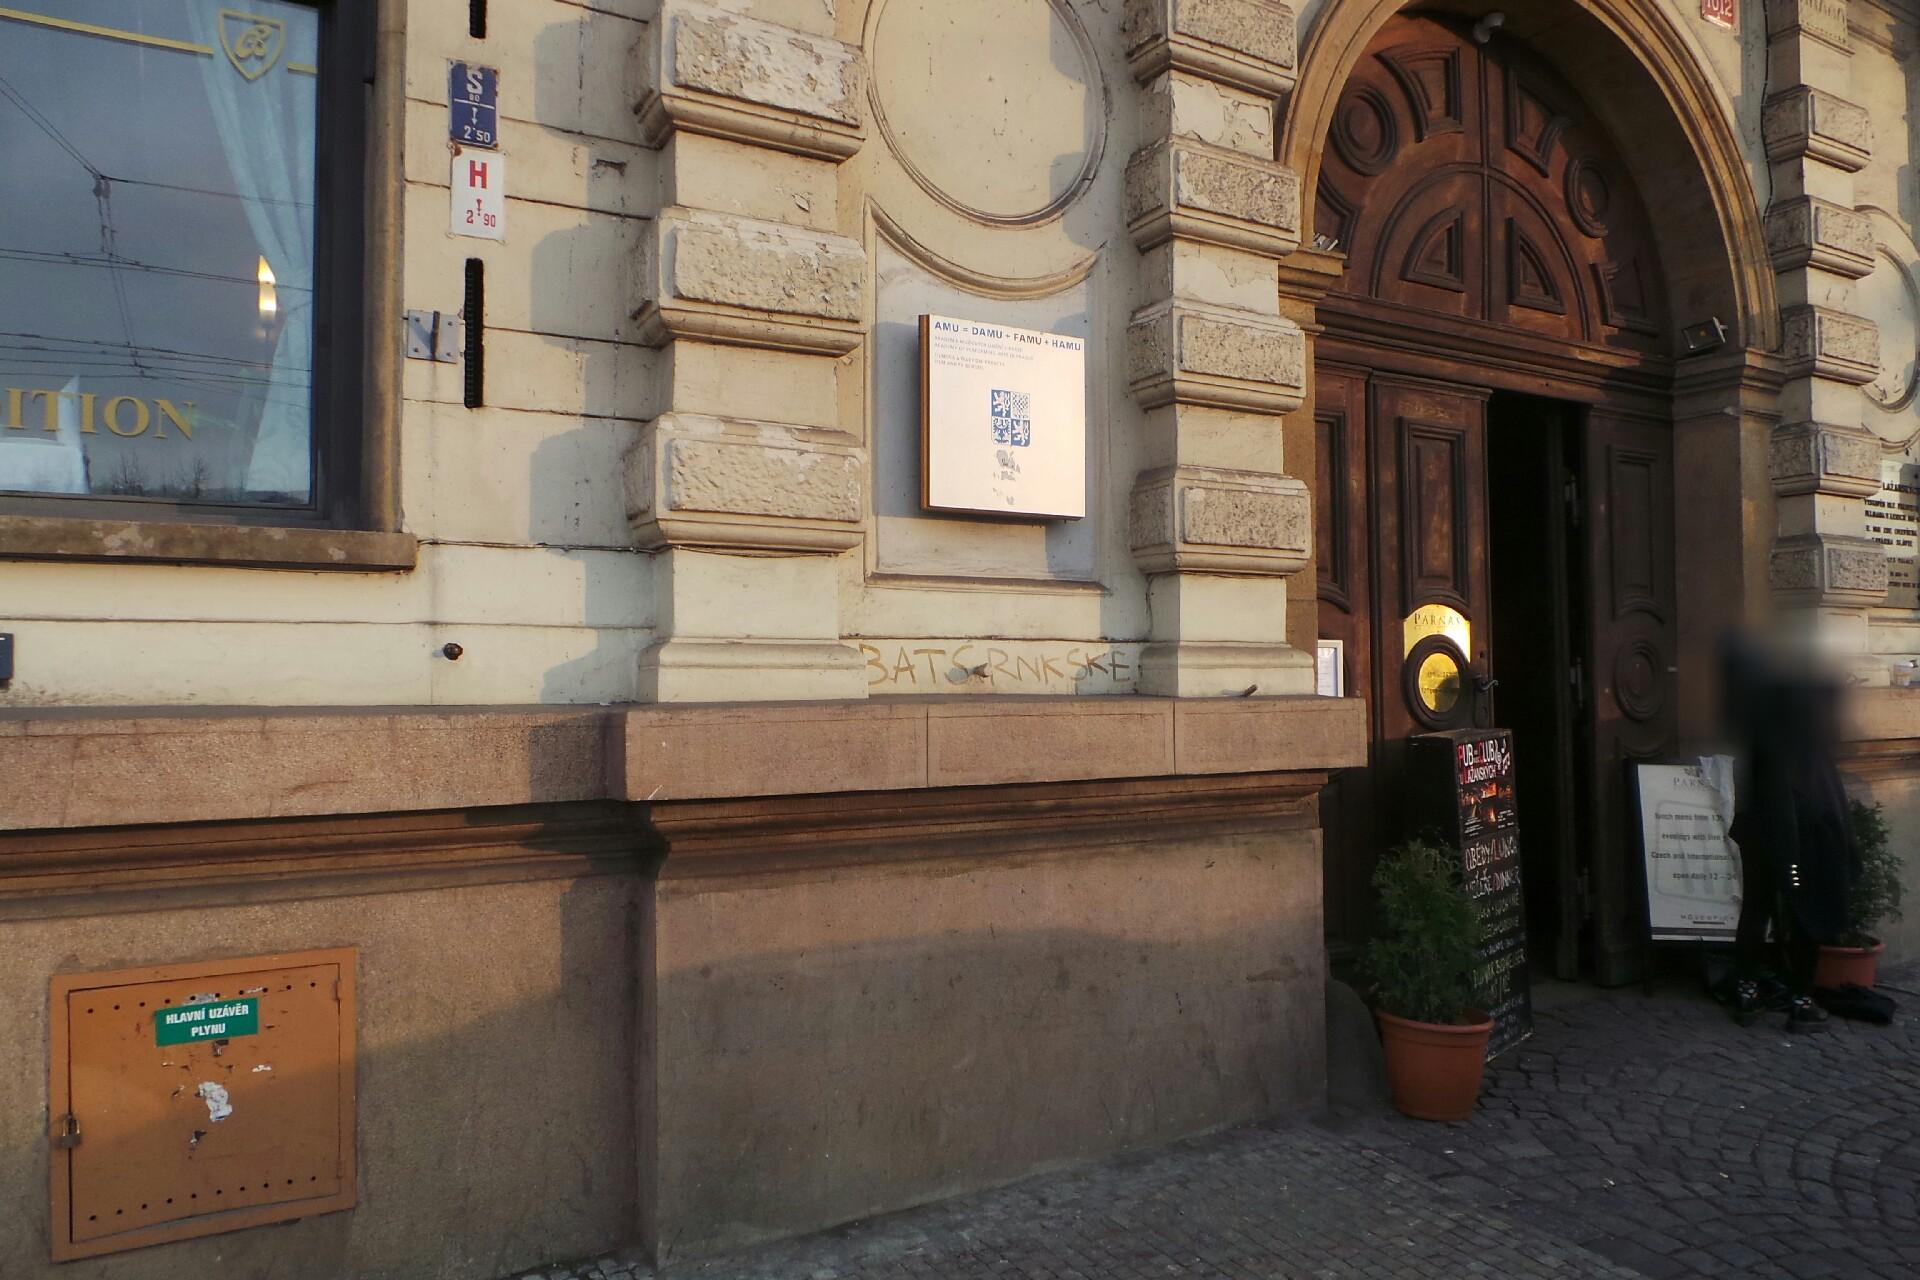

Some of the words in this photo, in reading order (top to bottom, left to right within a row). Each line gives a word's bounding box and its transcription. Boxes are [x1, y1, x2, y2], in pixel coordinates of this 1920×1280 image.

[466, 67, 483, 95] S
[469, 160, 487, 189] H
[935, 321, 959, 332] AMU
[972, 327, 1003, 339] DAMU
[1014, 333, 1042, 345] FAMU
[1052, 340, 1081, 351] HAMU
[0, 388, 195, 441] ITION
[1457, 743, 1474, 768] PUB
[166, 1008, 205, 1024] HLAVNÍ
[208, 1004, 248, 1018] UZÁVĚR
[191, 1024, 226, 1037] PLYNU
